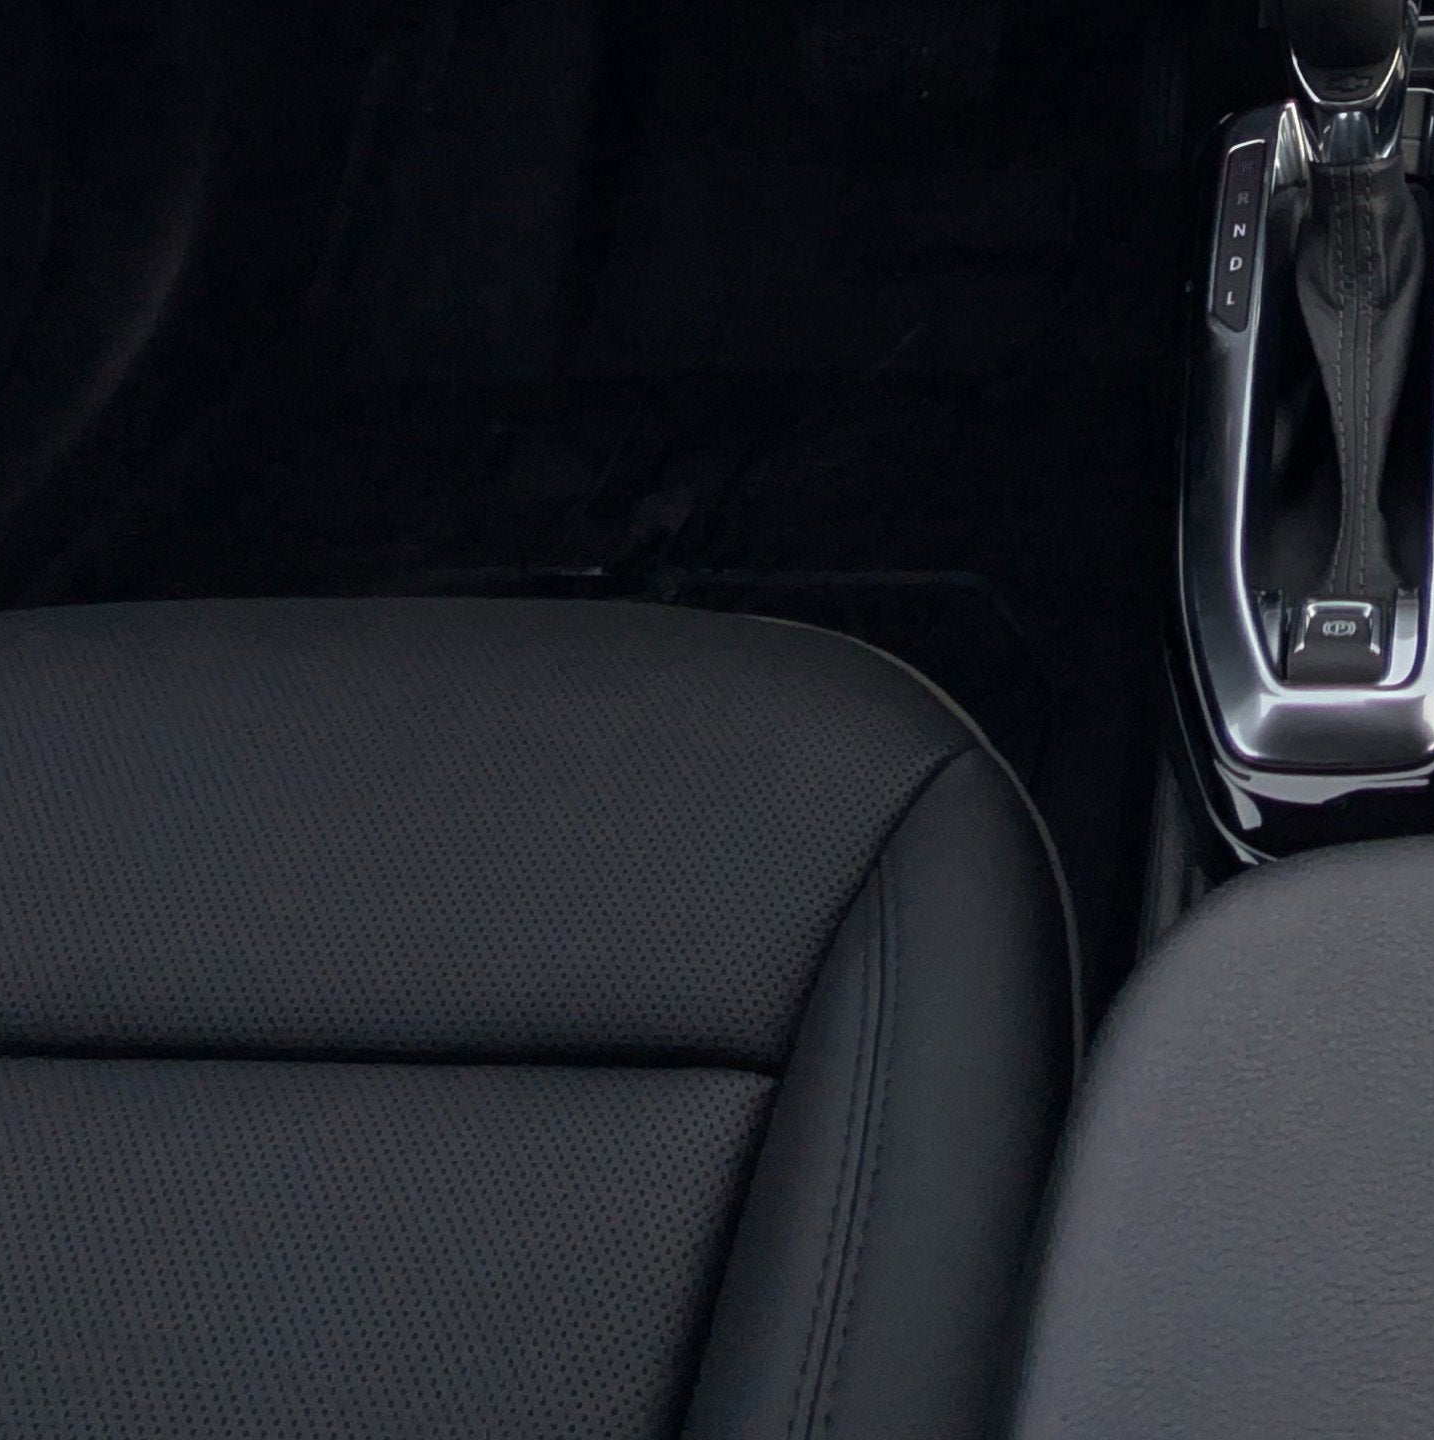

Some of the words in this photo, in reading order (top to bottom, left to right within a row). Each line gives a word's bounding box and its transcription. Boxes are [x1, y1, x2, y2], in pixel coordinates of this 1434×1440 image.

[1233, 222, 1247, 238] N
[1229, 256, 1243, 272] D
[1226, 291, 1236, 306] L
